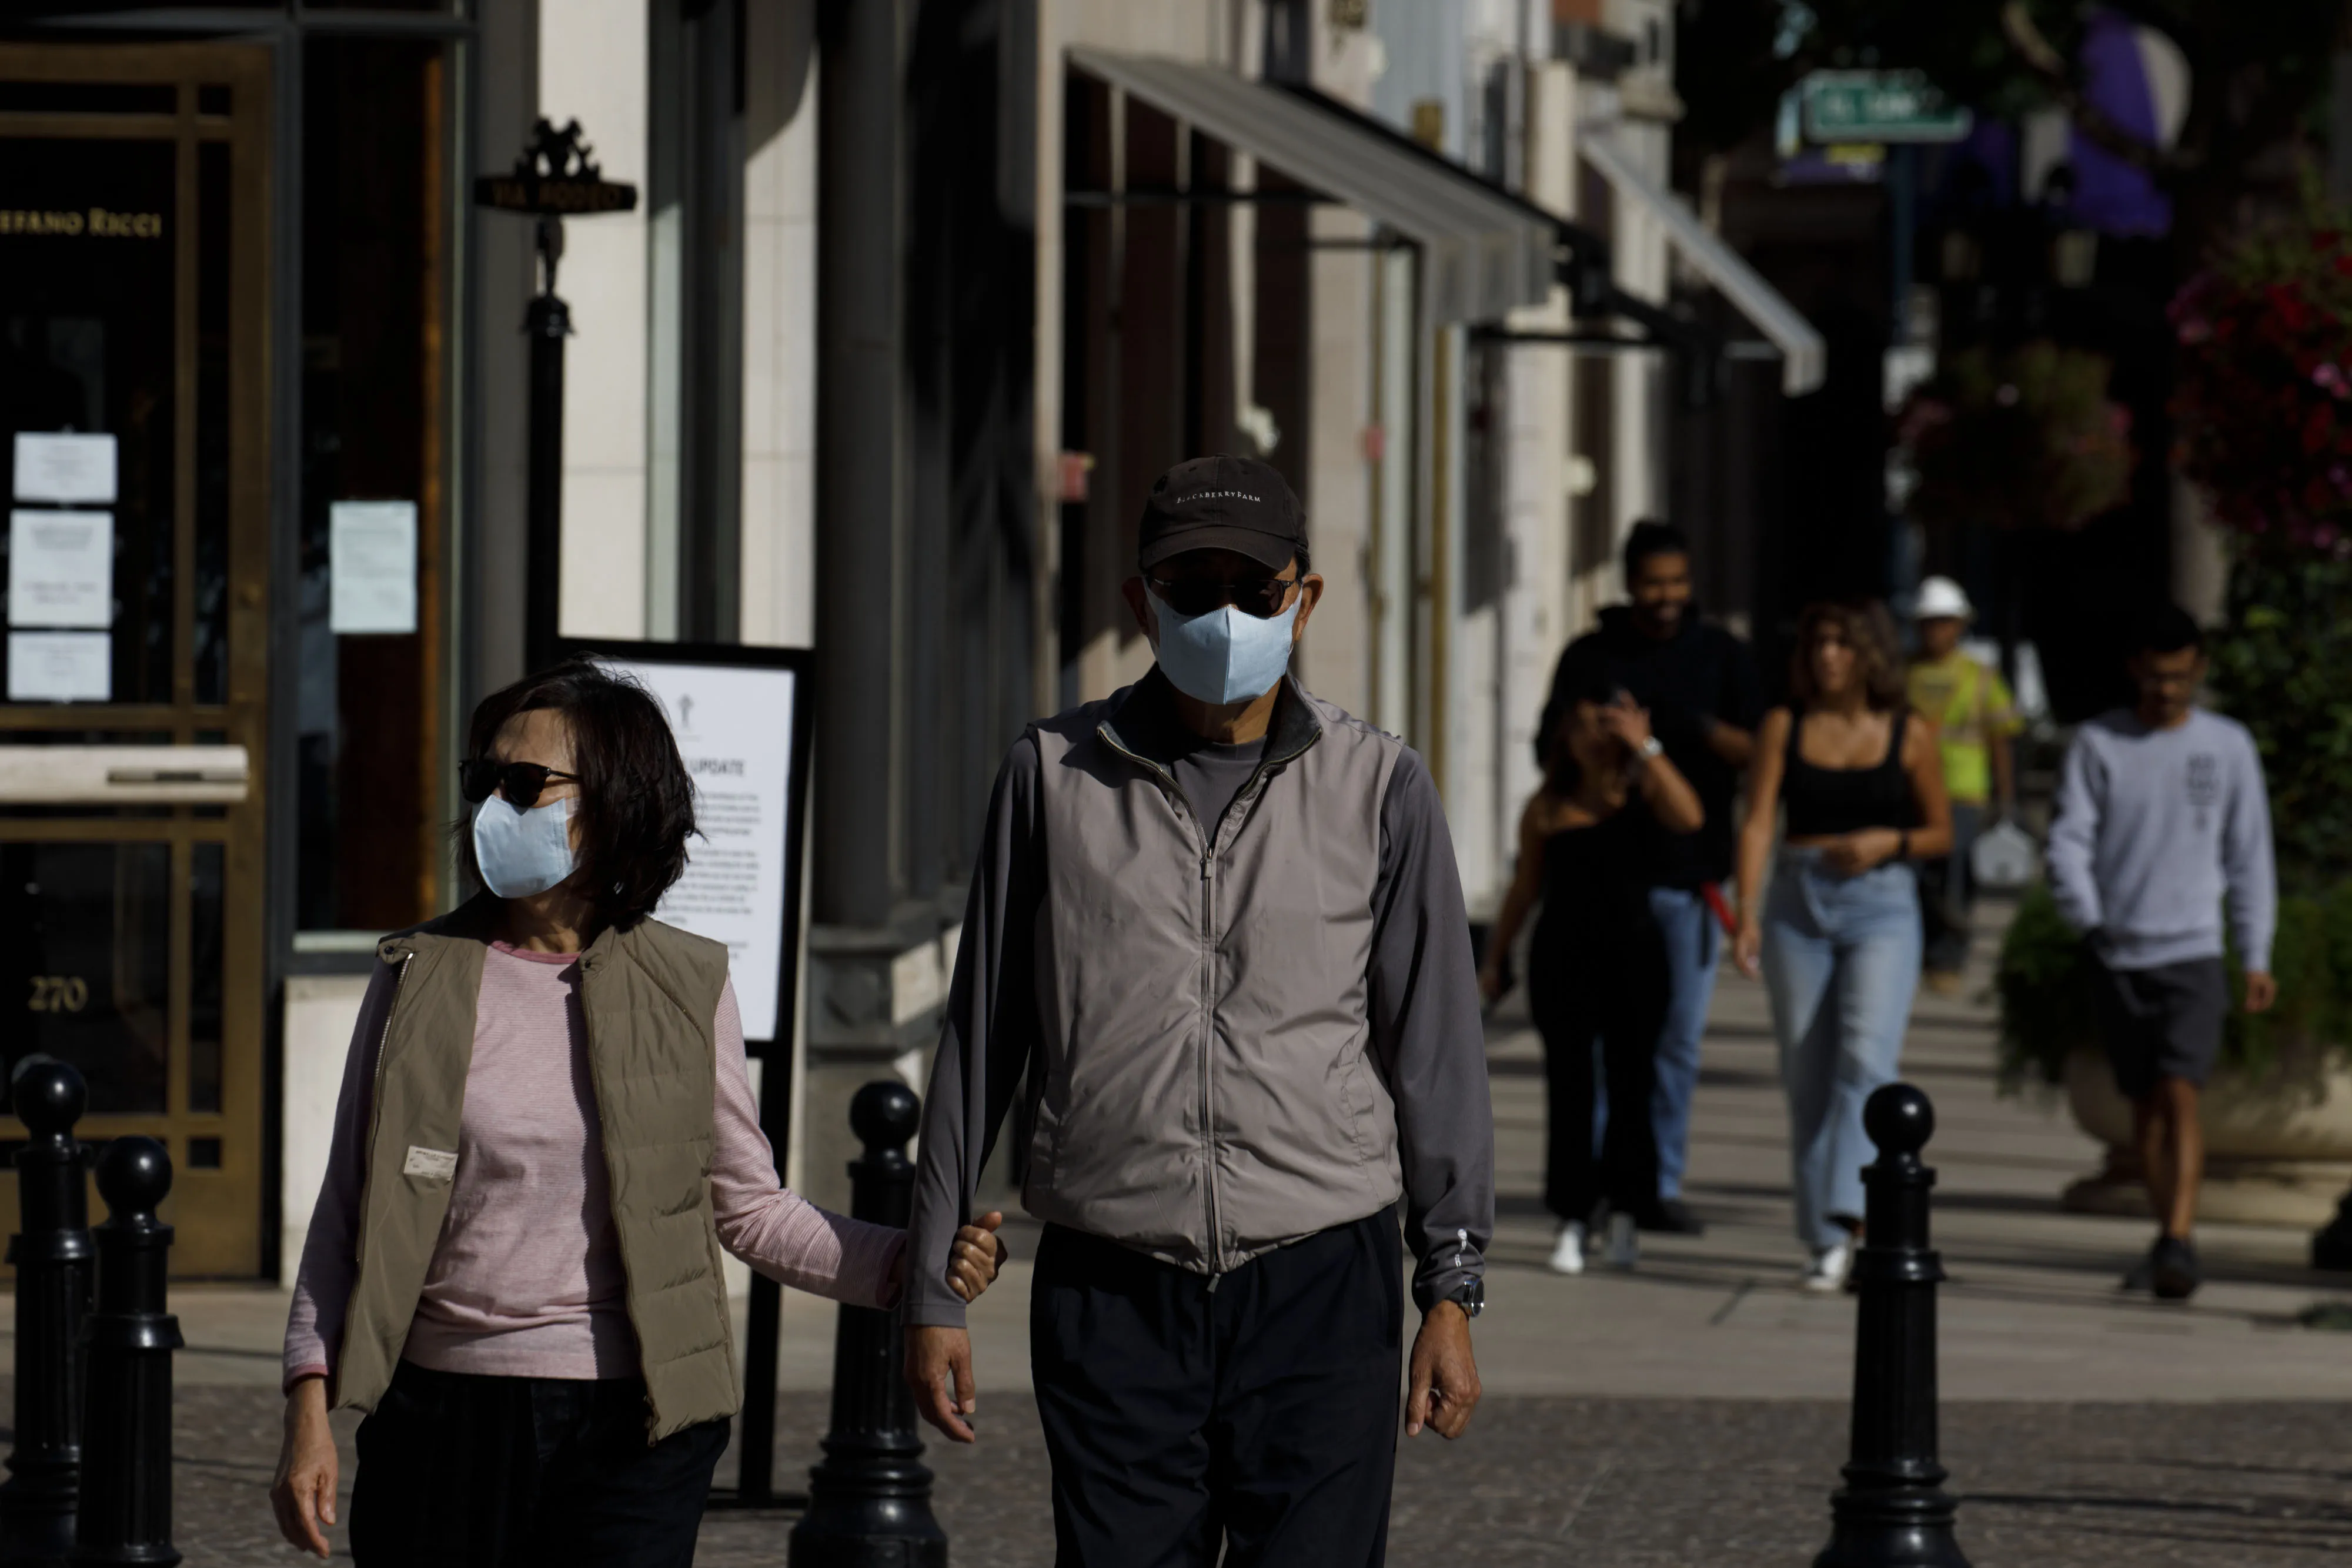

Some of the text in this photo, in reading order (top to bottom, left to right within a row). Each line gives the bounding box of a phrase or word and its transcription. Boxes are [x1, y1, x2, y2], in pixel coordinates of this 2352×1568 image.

[88, 206, 162, 238] RICCI
[690, 758, 744, 776] UPDATE
[28, 975, 88, 1012] 270
